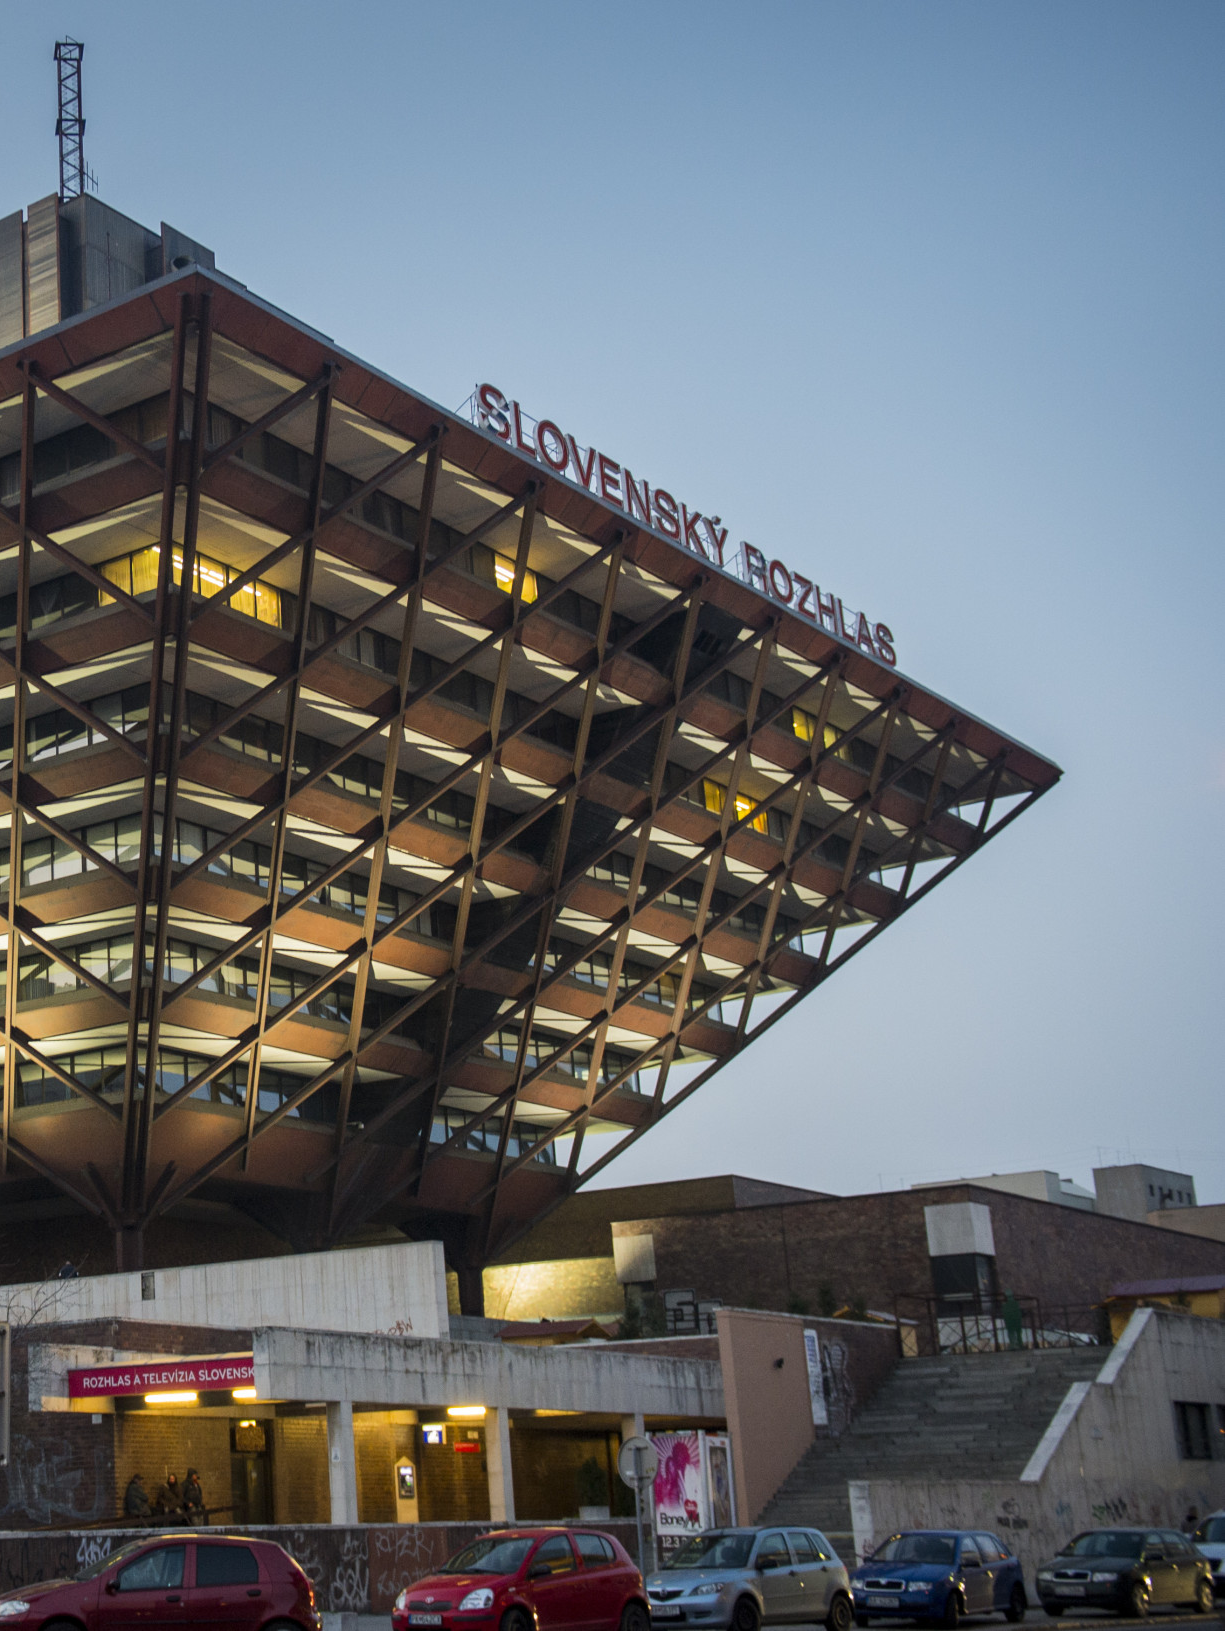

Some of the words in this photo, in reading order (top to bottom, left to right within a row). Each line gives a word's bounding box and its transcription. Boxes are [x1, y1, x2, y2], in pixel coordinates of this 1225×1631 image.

[475, 383, 729, 567] SLOVENSKÝ
[740, 541, 897, 667] ROZHLAS
[83, 1374, 131, 1388] ROZHLAS
[134, 1374, 141, 1385] A
[143, 1368, 195, 1384] TELEVÍZIA
[198, 1367, 255, 1382] SLOVENSK
[660, 1512, 685, 1528] Boney
